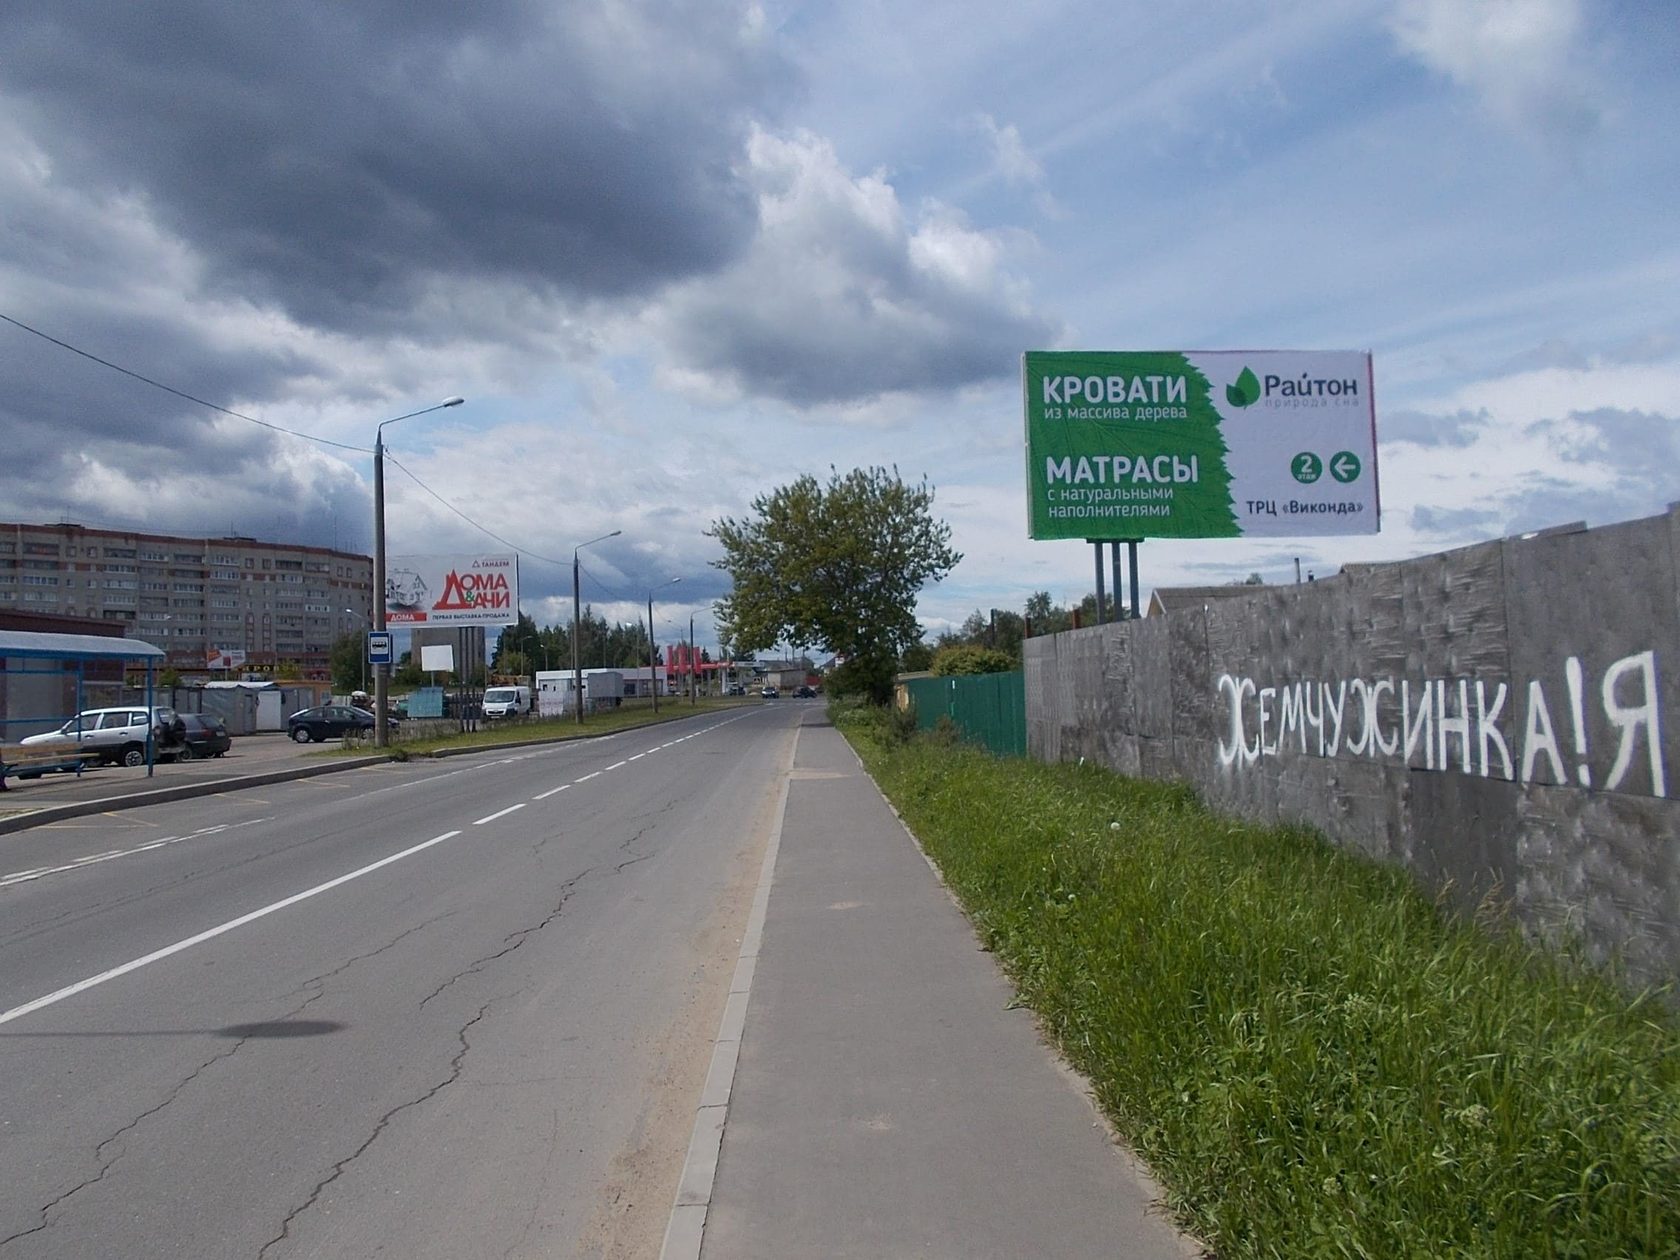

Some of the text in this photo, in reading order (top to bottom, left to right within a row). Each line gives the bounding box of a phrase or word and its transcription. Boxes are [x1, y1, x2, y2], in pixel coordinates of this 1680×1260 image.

[1043, 375, 1187, 404] КРОВАТИ
[1264, 372, 1357, 397] Райтон
[1265, 398, 1360, 408] природа сна
[1044, 407, 1187, 422] из массива дерева
[1046, 455, 1198, 484] МАТРАСЫ
[1301, 455, 1313, 473] 2
[1047, 488, 1173, 503] с натуральными
[1049, 504, 1170, 518] наполнителями
[1247, 500, 1364, 517] ТРЦ «Виконда»
[390, 613, 415, 622] ДОМА
[1603, 650, 1666, 798] Я
